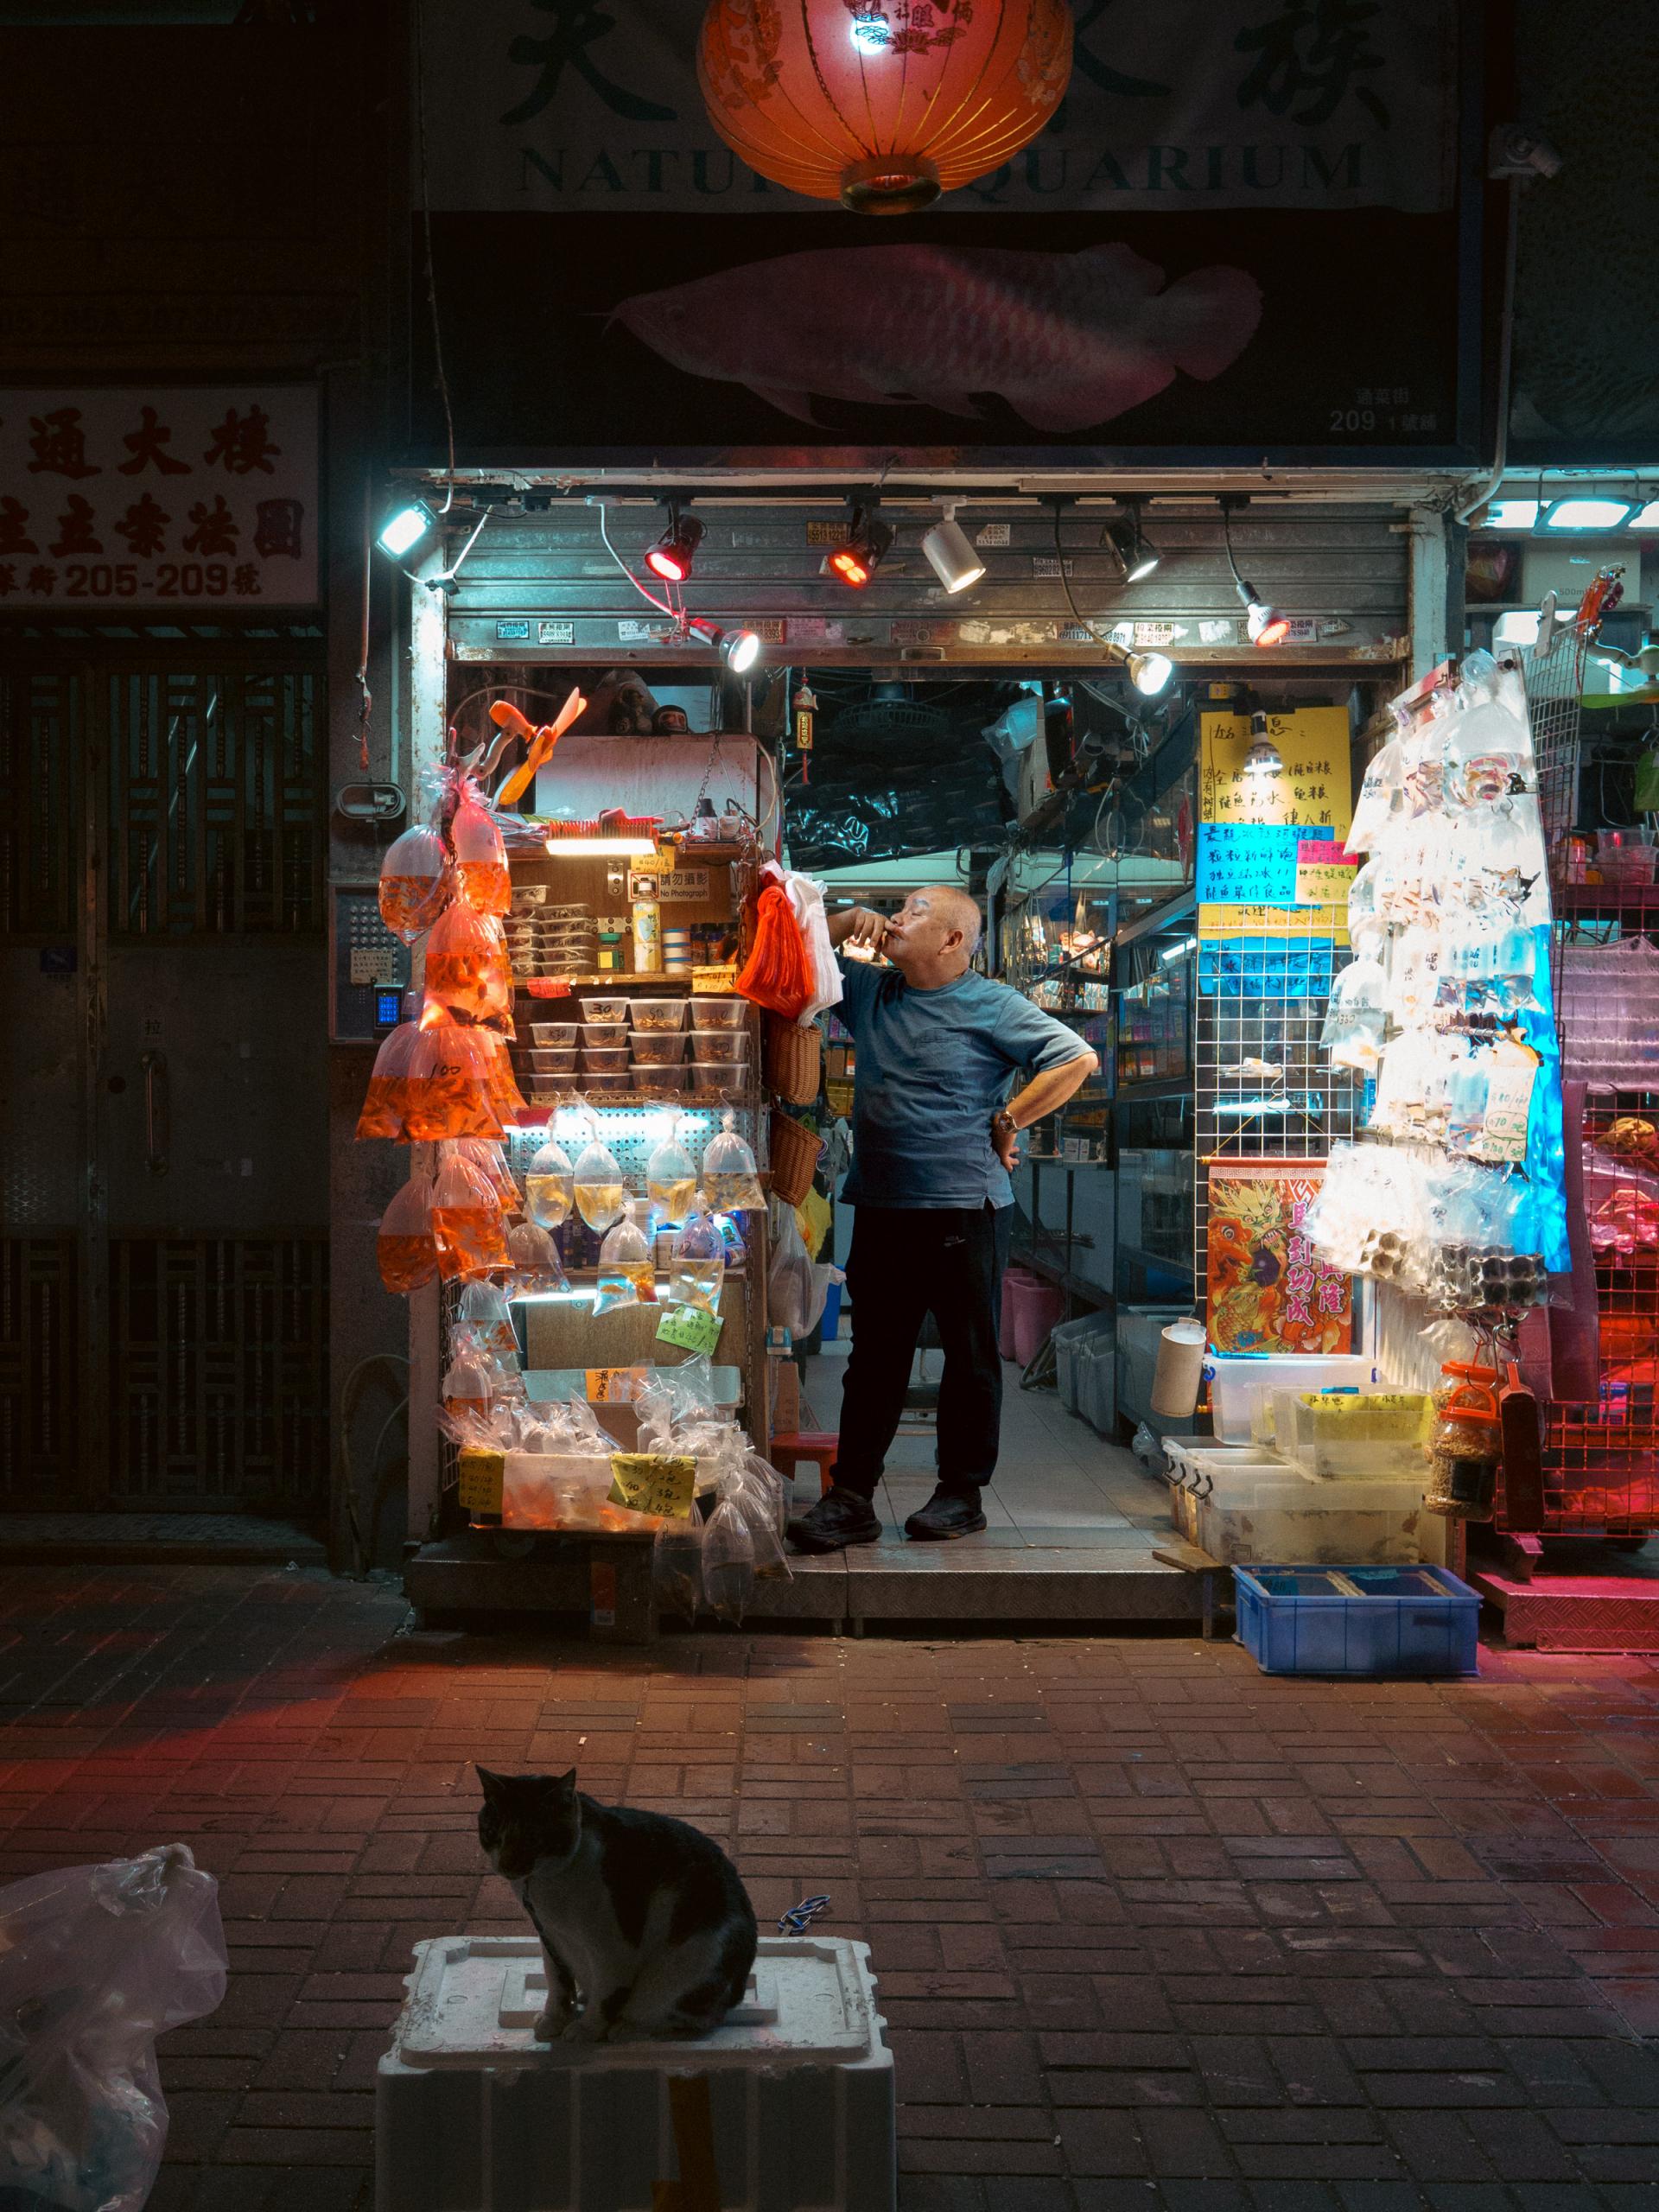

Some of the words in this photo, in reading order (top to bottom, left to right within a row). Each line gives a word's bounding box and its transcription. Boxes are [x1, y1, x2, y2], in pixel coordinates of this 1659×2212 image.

[965, 143, 1367, 204] QUARIUM
[1330, 410, 1376, 431] 209
[671, 889, 708, 899] Photograph
[588, 1002, 613, 1014] 30
[429, 1063, 461, 1079] 100
